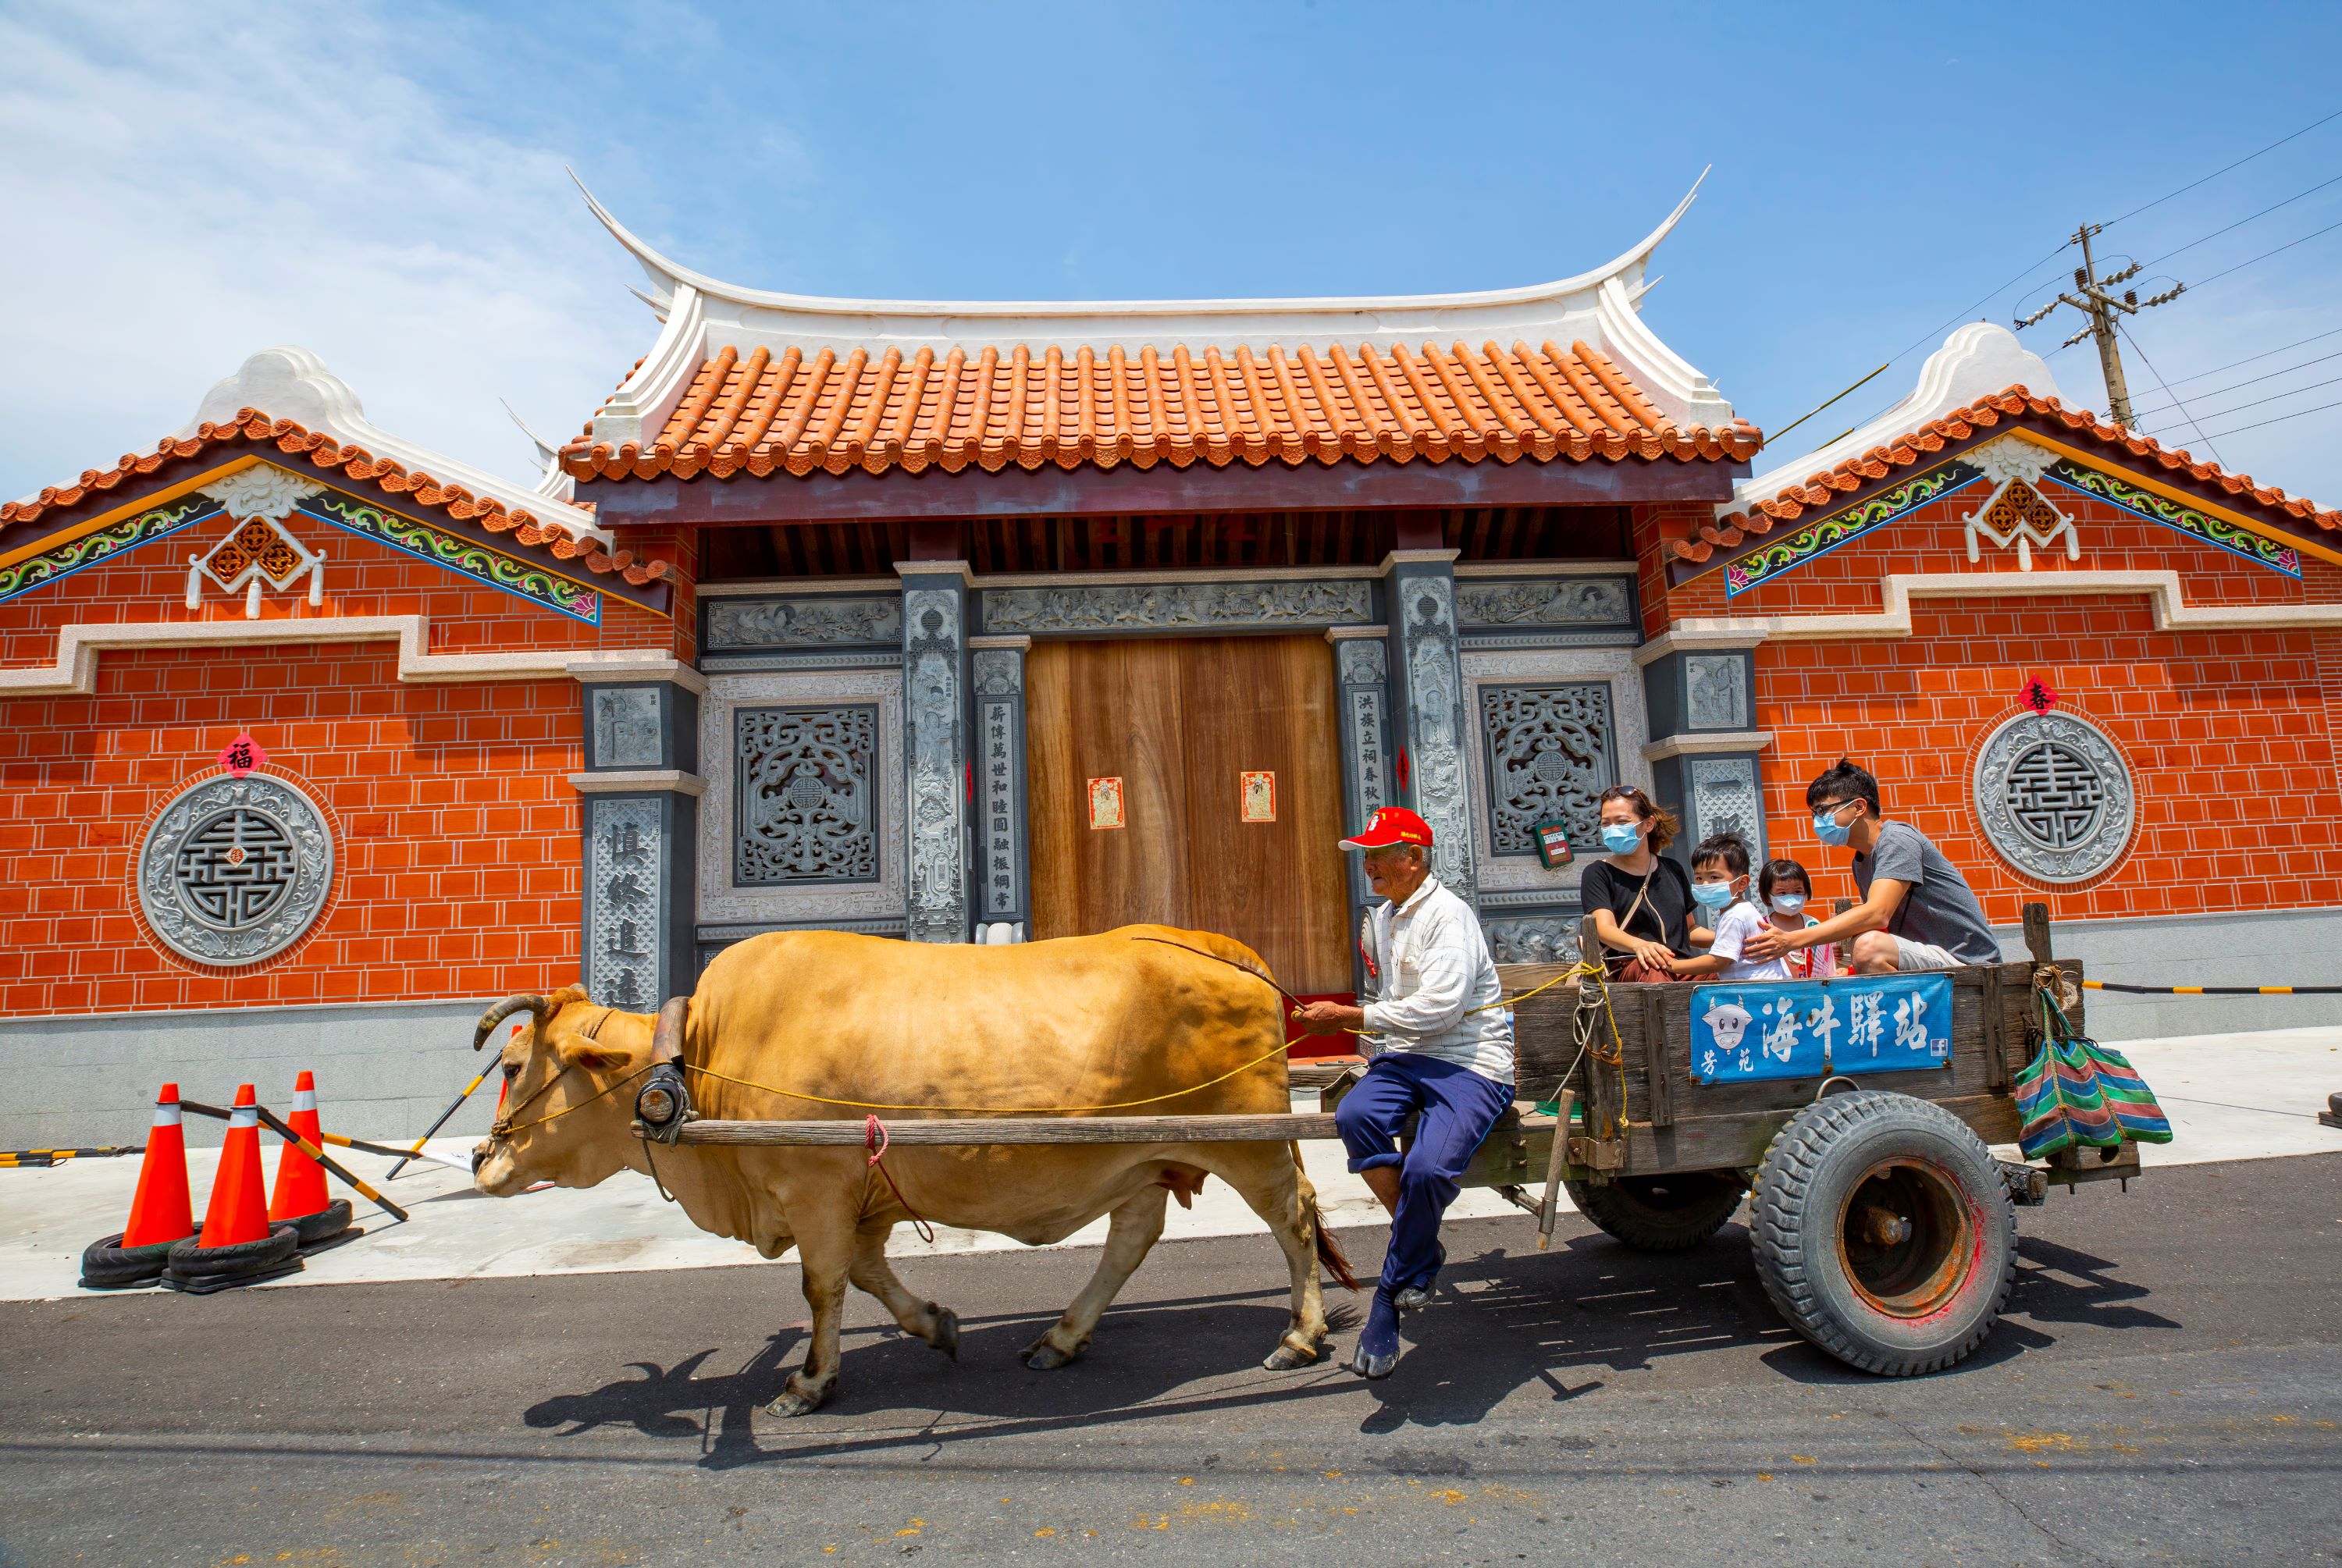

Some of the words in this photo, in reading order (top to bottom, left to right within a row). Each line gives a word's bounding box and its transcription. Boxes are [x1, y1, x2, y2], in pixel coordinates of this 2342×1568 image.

[2030, 683, 2052, 709] 春
[227, 742, 253, 770] 福
[990, 705, 1011, 910] 薪傳萬世和睦圓融振綱常
[1762, 991, 1928, 1062] 海牛驛站
[1700, 1048, 1754, 1076] 芳苑
